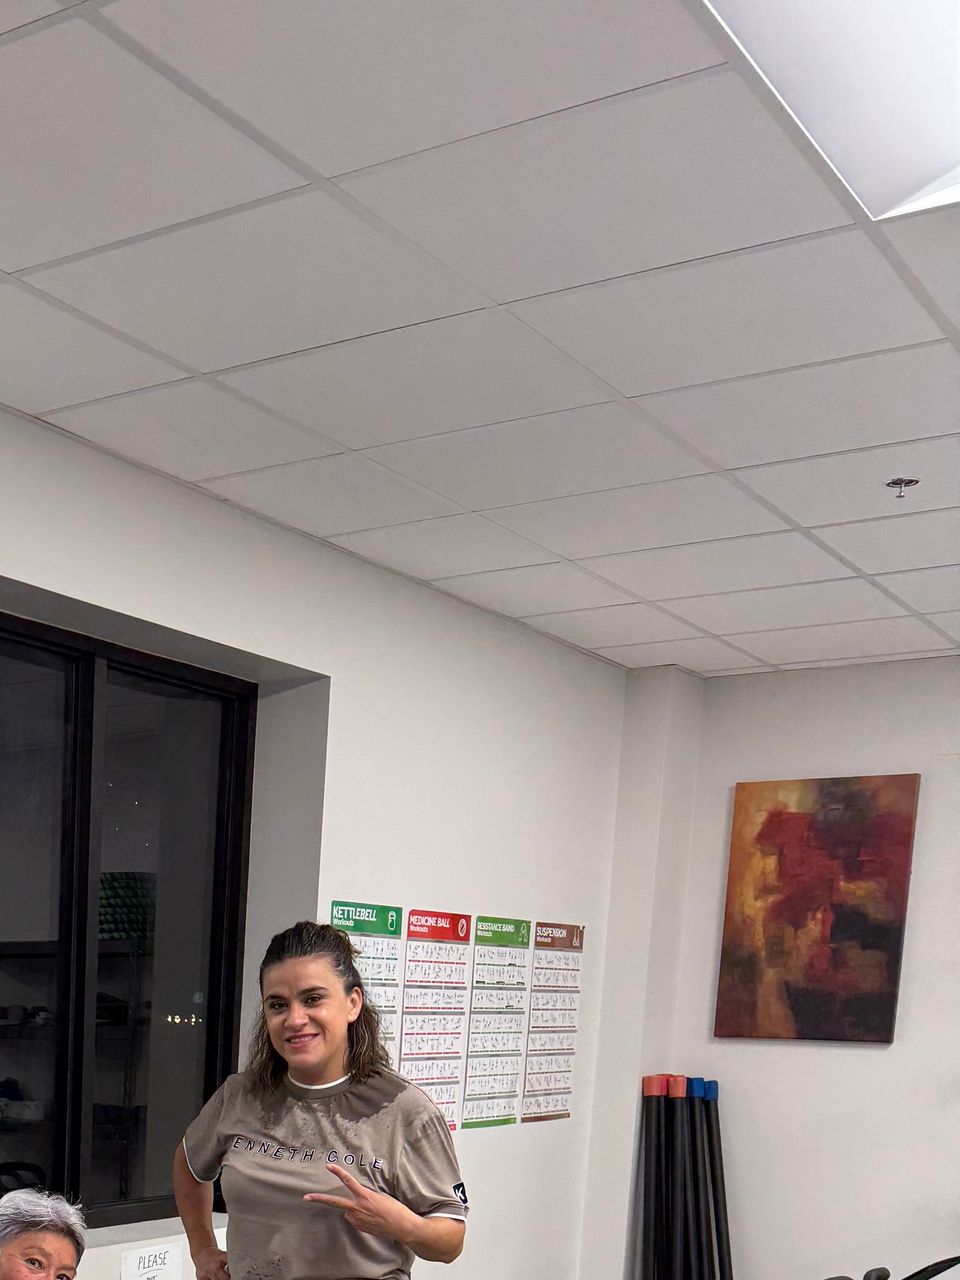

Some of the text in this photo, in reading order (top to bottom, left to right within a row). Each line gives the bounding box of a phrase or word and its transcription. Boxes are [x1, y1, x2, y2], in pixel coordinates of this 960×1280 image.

[333, 906, 377, 921] KETTLEBELL
[410, 915, 450, 928] MEDICINE BALL
[477, 922, 515, 932] RESISTANCE BAND
[536, 927, 567, 938] SUSPENSION
[232, 1135, 384, 1170] ENNETH COLE
[455, 1187, 465, 1200] K
[137, 1250, 169, 1271] PLEASE
